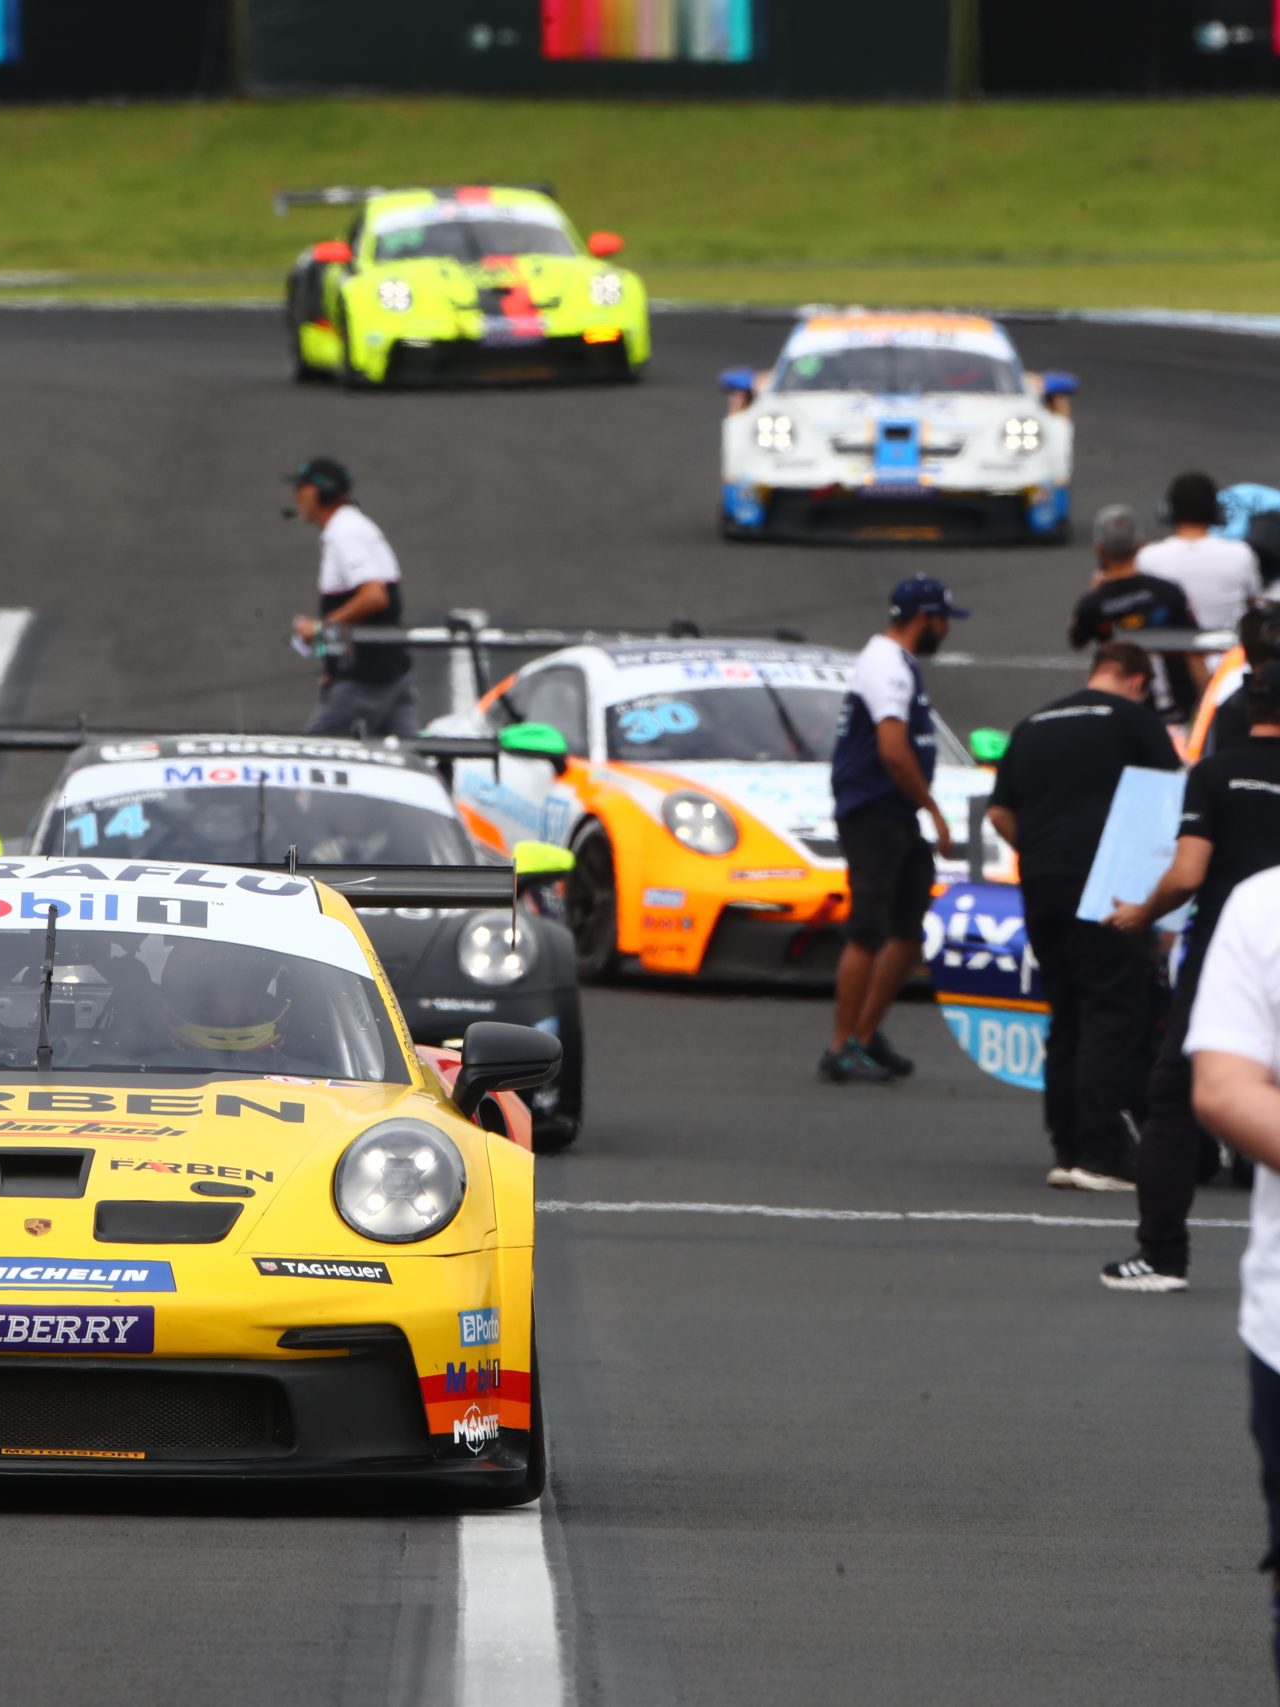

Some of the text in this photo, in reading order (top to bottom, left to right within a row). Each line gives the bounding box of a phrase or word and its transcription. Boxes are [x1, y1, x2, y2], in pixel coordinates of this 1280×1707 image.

[618, 700, 699, 743] 30
[163, 765, 301, 785] Mobil
[66, 803, 151, 849] 14
[110, 1159, 274, 1182] FARBEN
[476, 1314, 499, 1341] Porto
